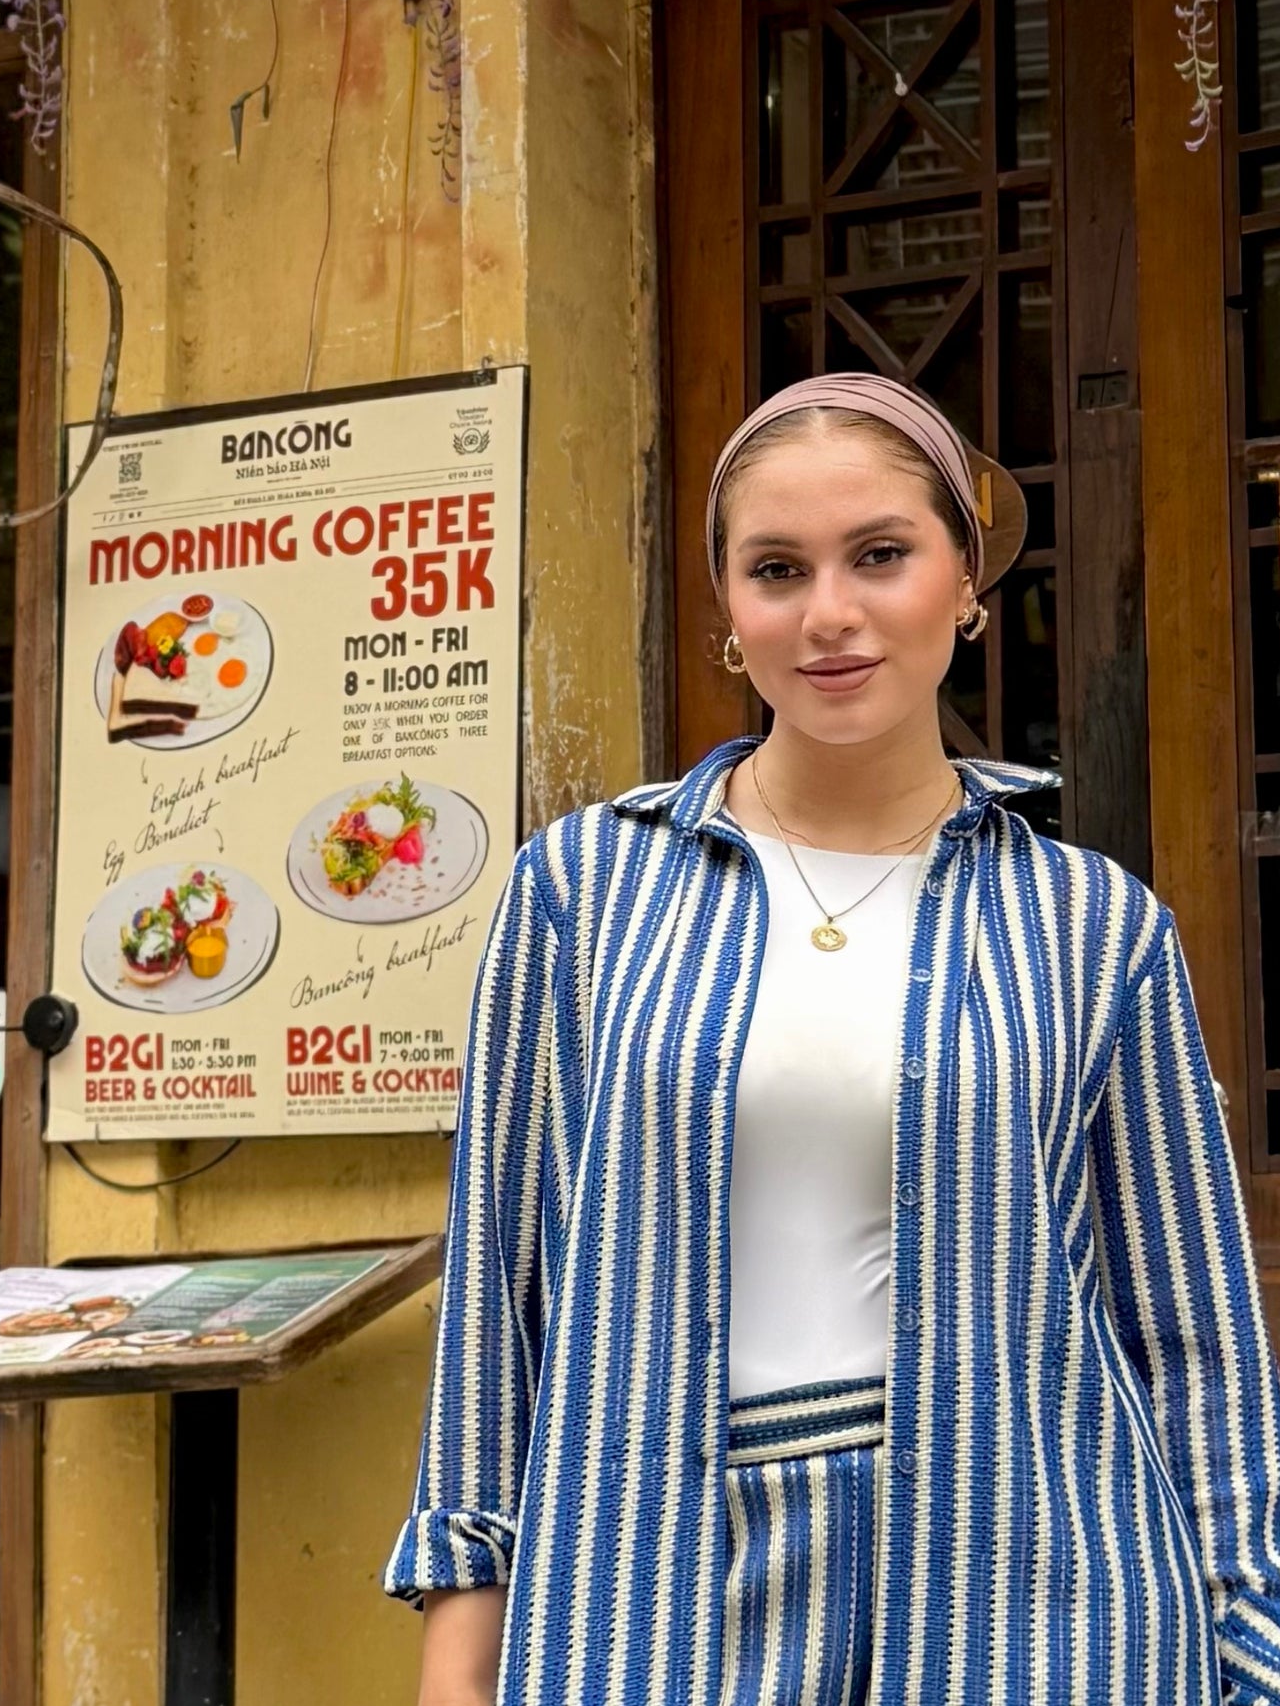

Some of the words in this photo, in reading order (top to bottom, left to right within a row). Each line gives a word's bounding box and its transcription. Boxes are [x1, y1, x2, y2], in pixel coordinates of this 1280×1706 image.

[89, 515, 297, 585] MORNING
[312, 492, 495, 557] COFFEE
[371, 547, 495, 622] 35K
[344, 631, 407, 661] MON
[432, 625, 468, 653] FRI
[344, 671, 358, 696] 8
[383, 663, 439, 693] 11:00
[446, 660, 488, 688] AM
[344, 703, 372, 715] ENJOY
[374, 702, 381, 712] A
[384, 698, 429, 712] MORNING
[432, 695, 465, 708] COFFEE
[469, 693, 488, 704] FOR
[343, 719, 367, 731] ONLY
[396, 714, 423, 726] WHEN
[429, 712, 450, 723] YOU
[455, 709, 488, 722] ORDER
[343, 734, 361, 747] ONE
[372, 733, 384, 744] OF
[459, 725, 488, 737] THREE
[343, 748, 391, 762] BREAKFAST
[150, 767, 205, 824] English
[215, 729, 300, 784] breakfast
[103, 841, 125, 886] Egg
[385, 917, 478, 973] breakfast
[171, 1039, 201, 1053] MON
[212, 1038, 230, 1051] FRI
[379, 1030, 412, 1044] MON
[424, 1029, 444, 1043] FRI
[237, 1054, 256, 1068] PM
[380, 1049, 387, 1063] 7
[400, 1048, 431, 1062] 9:00
[434, 1047, 454, 1061] PM
[85, 1078, 136, 1103] BEER
[143, 1077, 156, 1100] &
[162, 1073, 257, 1100] COCKTAIL
[286, 1070, 345, 1096] WINE
[352, 1070, 366, 1094] &
